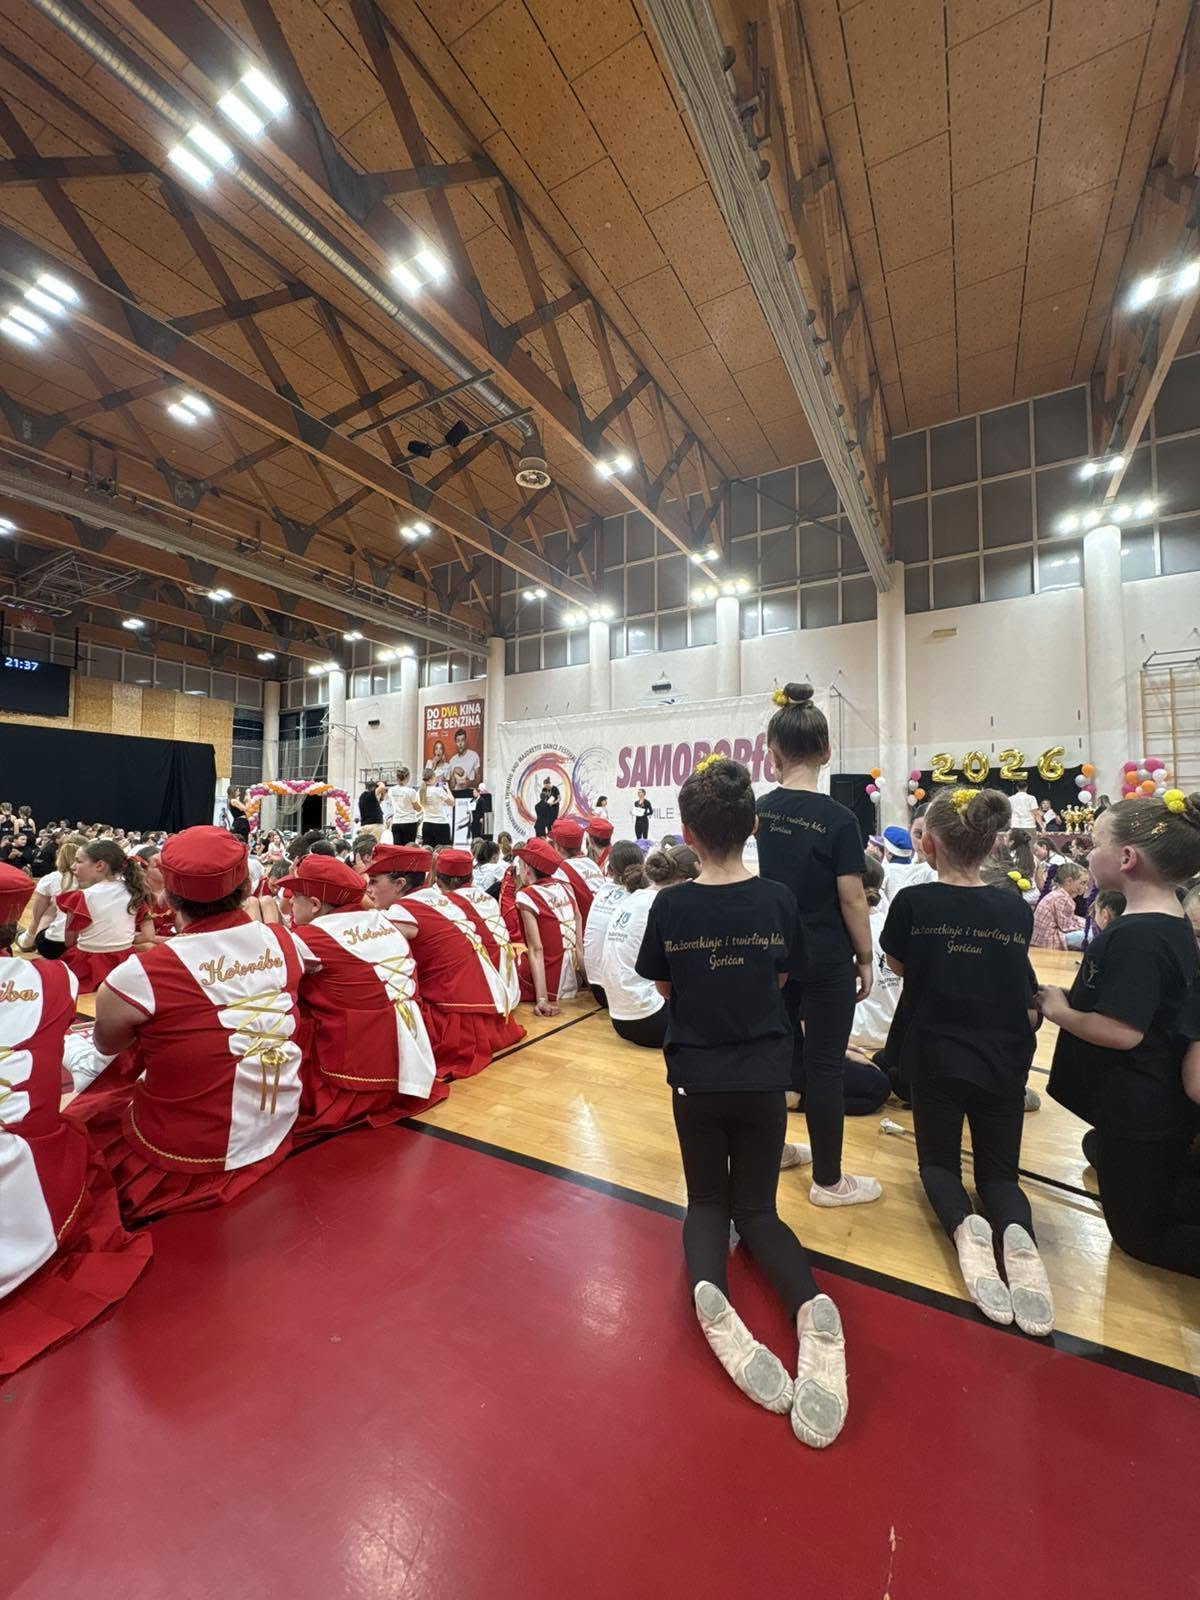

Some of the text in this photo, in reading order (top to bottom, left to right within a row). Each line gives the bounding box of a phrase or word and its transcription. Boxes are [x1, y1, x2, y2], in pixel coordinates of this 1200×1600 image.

[5, 657, 39, 670] 21:37
[427, 703, 481, 720] DO DVA KINA
[427, 714, 481, 730] BEZ BENZINA
[930, 746, 1065, 783] 2026
[732, 931, 769, 951] twirling
[973, 927, 1012, 946] twirling
